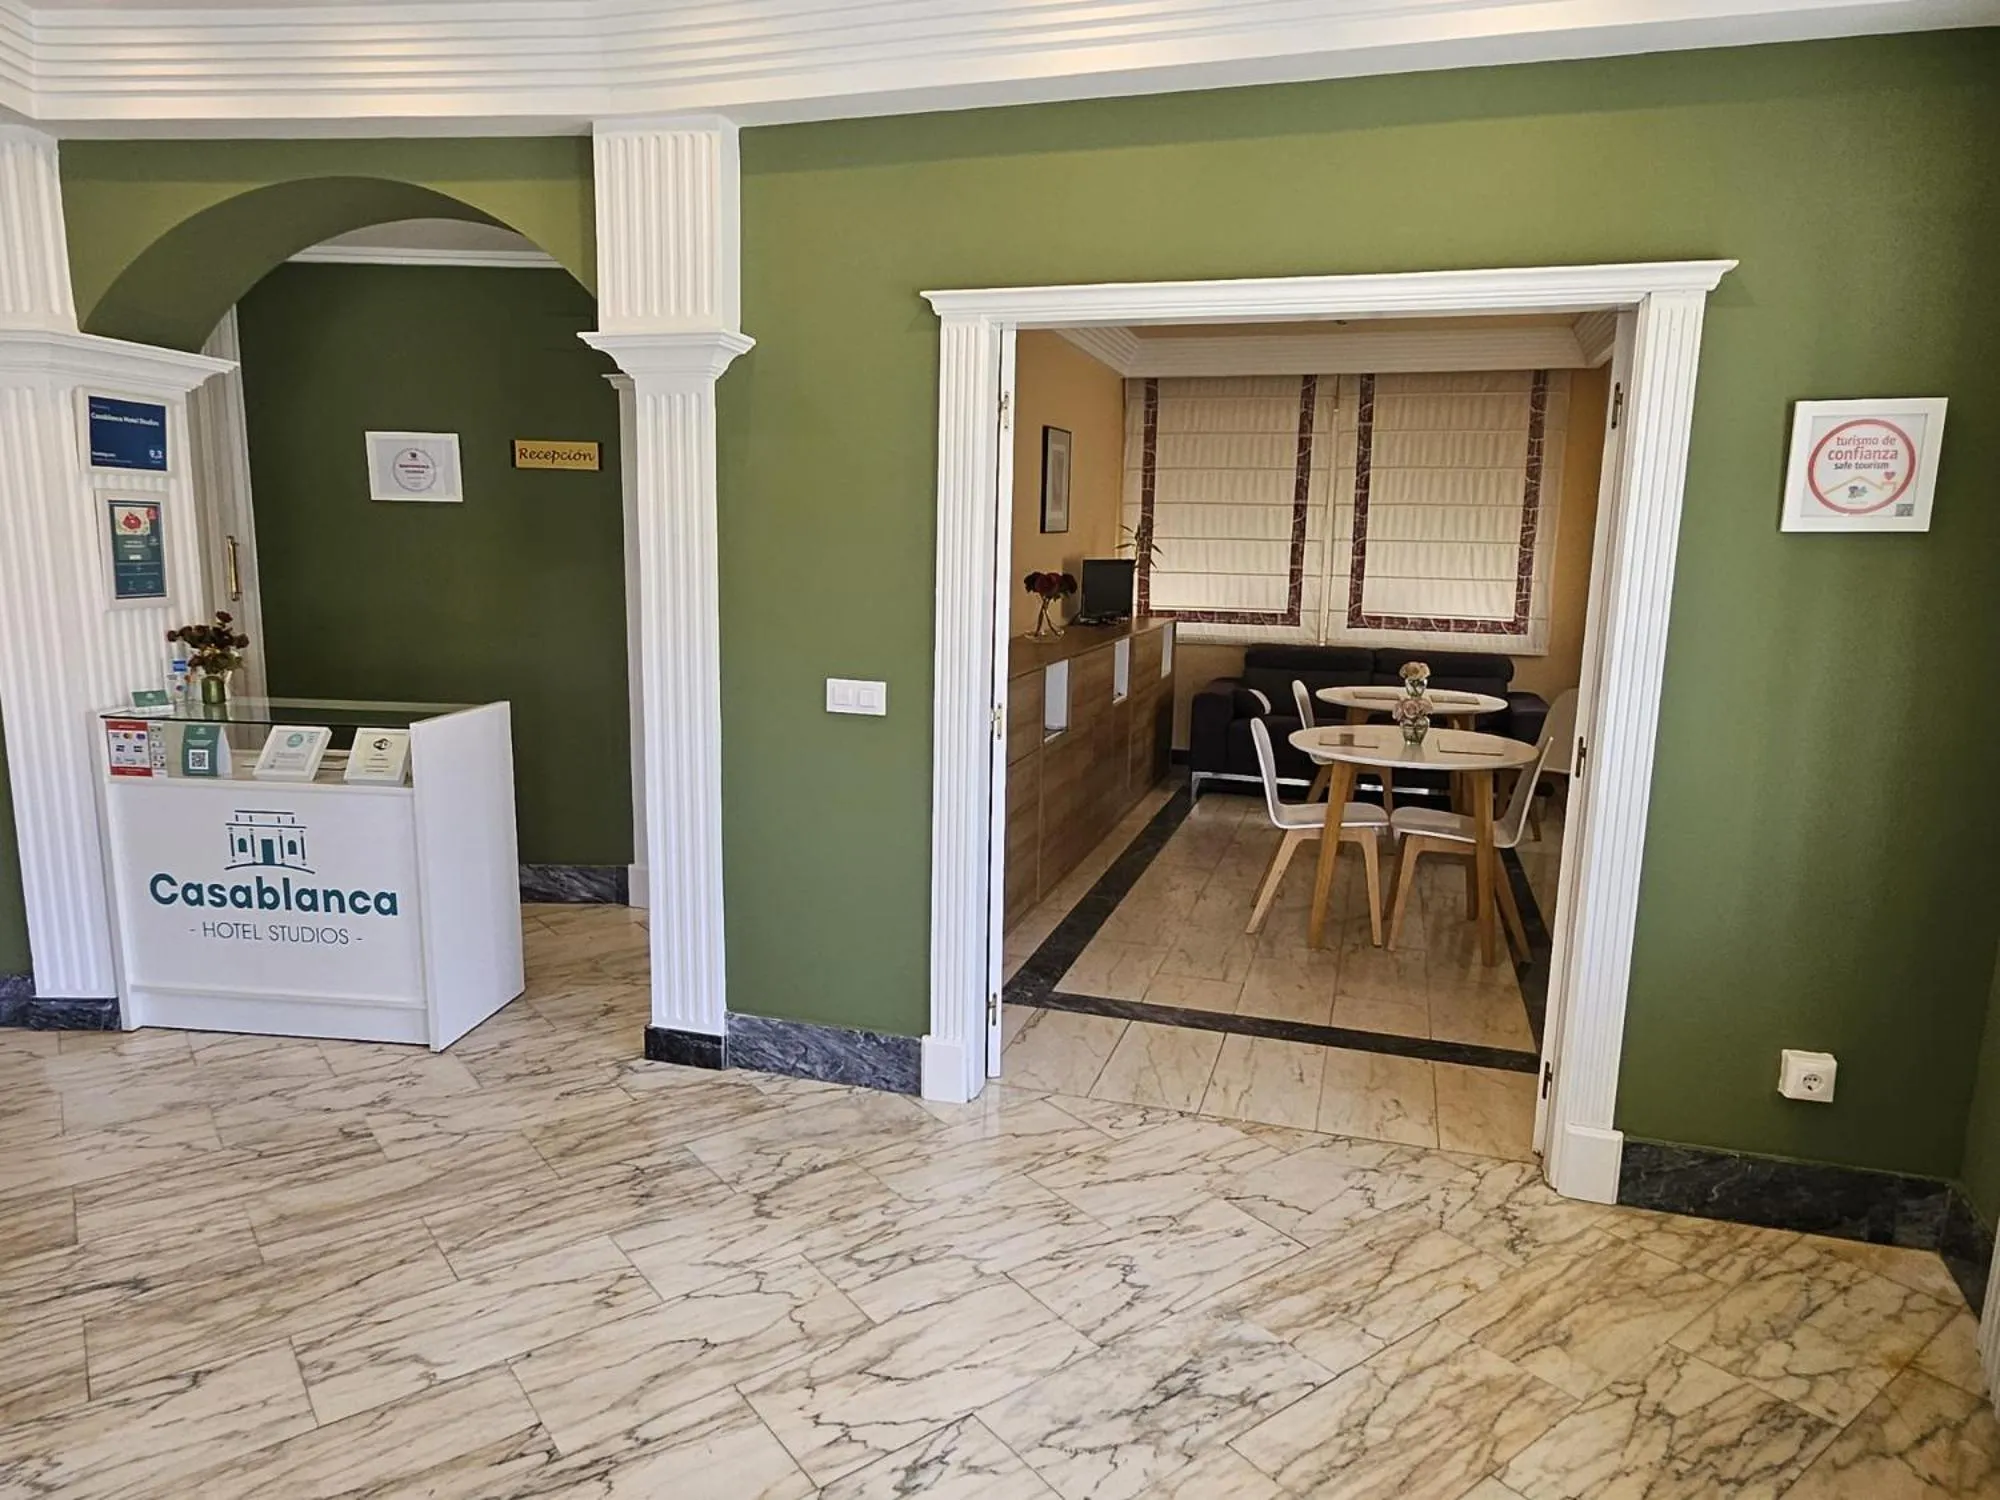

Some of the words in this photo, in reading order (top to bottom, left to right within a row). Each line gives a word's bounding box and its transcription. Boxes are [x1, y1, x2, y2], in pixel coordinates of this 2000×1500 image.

[1836, 435, 1878, 446] turismo
[1882, 435, 1896, 446] de
[518, 447, 593, 464] Recepción
[1827, 446, 1899, 461] confianza
[1834, 461, 1853, 470] safe
[1855, 462, 1889, 470] tourism
[149, 873, 398, 915] Casablanca
[203, 922, 262, 940] HOTEL
[268, 925, 349, 945] STUDIOS
